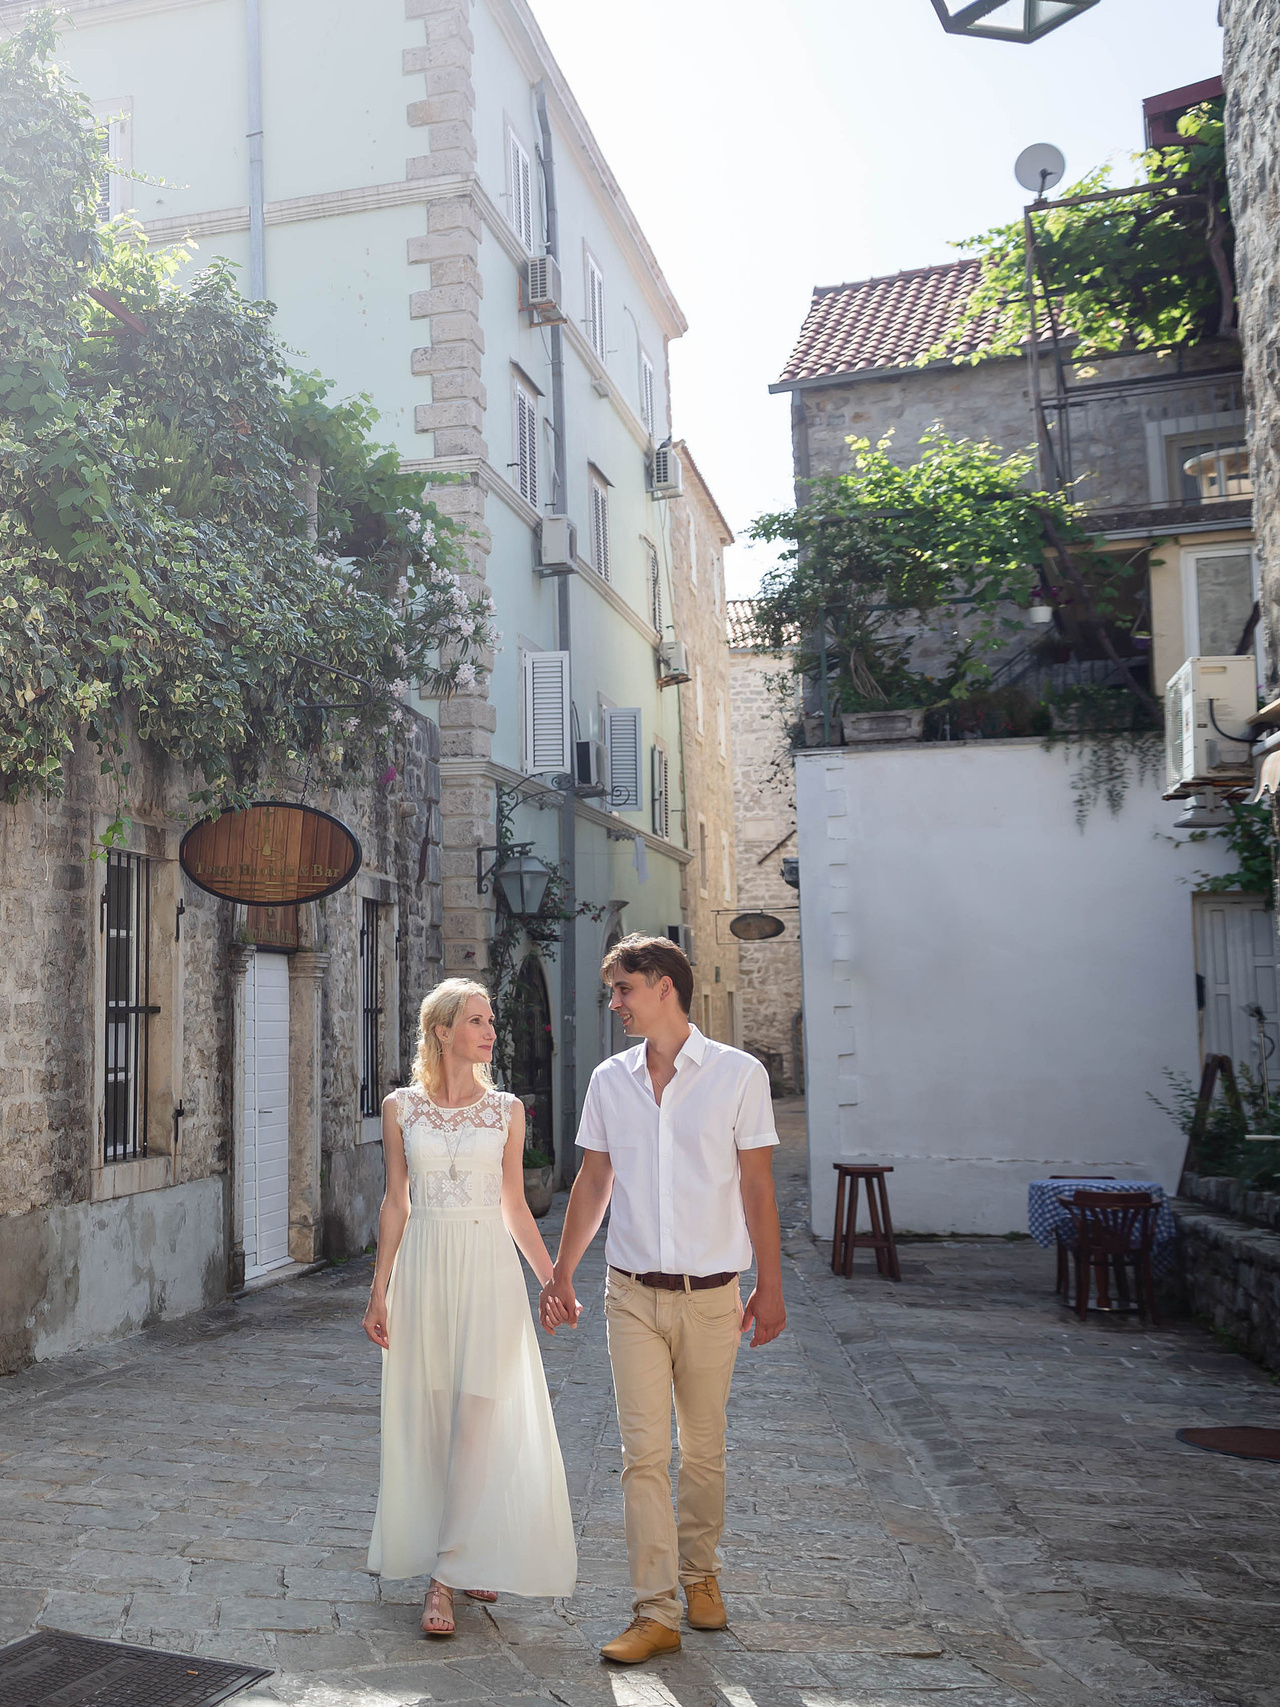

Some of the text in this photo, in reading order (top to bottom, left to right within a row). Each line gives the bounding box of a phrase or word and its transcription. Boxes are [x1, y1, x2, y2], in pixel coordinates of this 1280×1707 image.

[239, 863, 296, 877] Hookah
[299, 865, 309, 876] &
[312, 864, 341, 878] Bar
